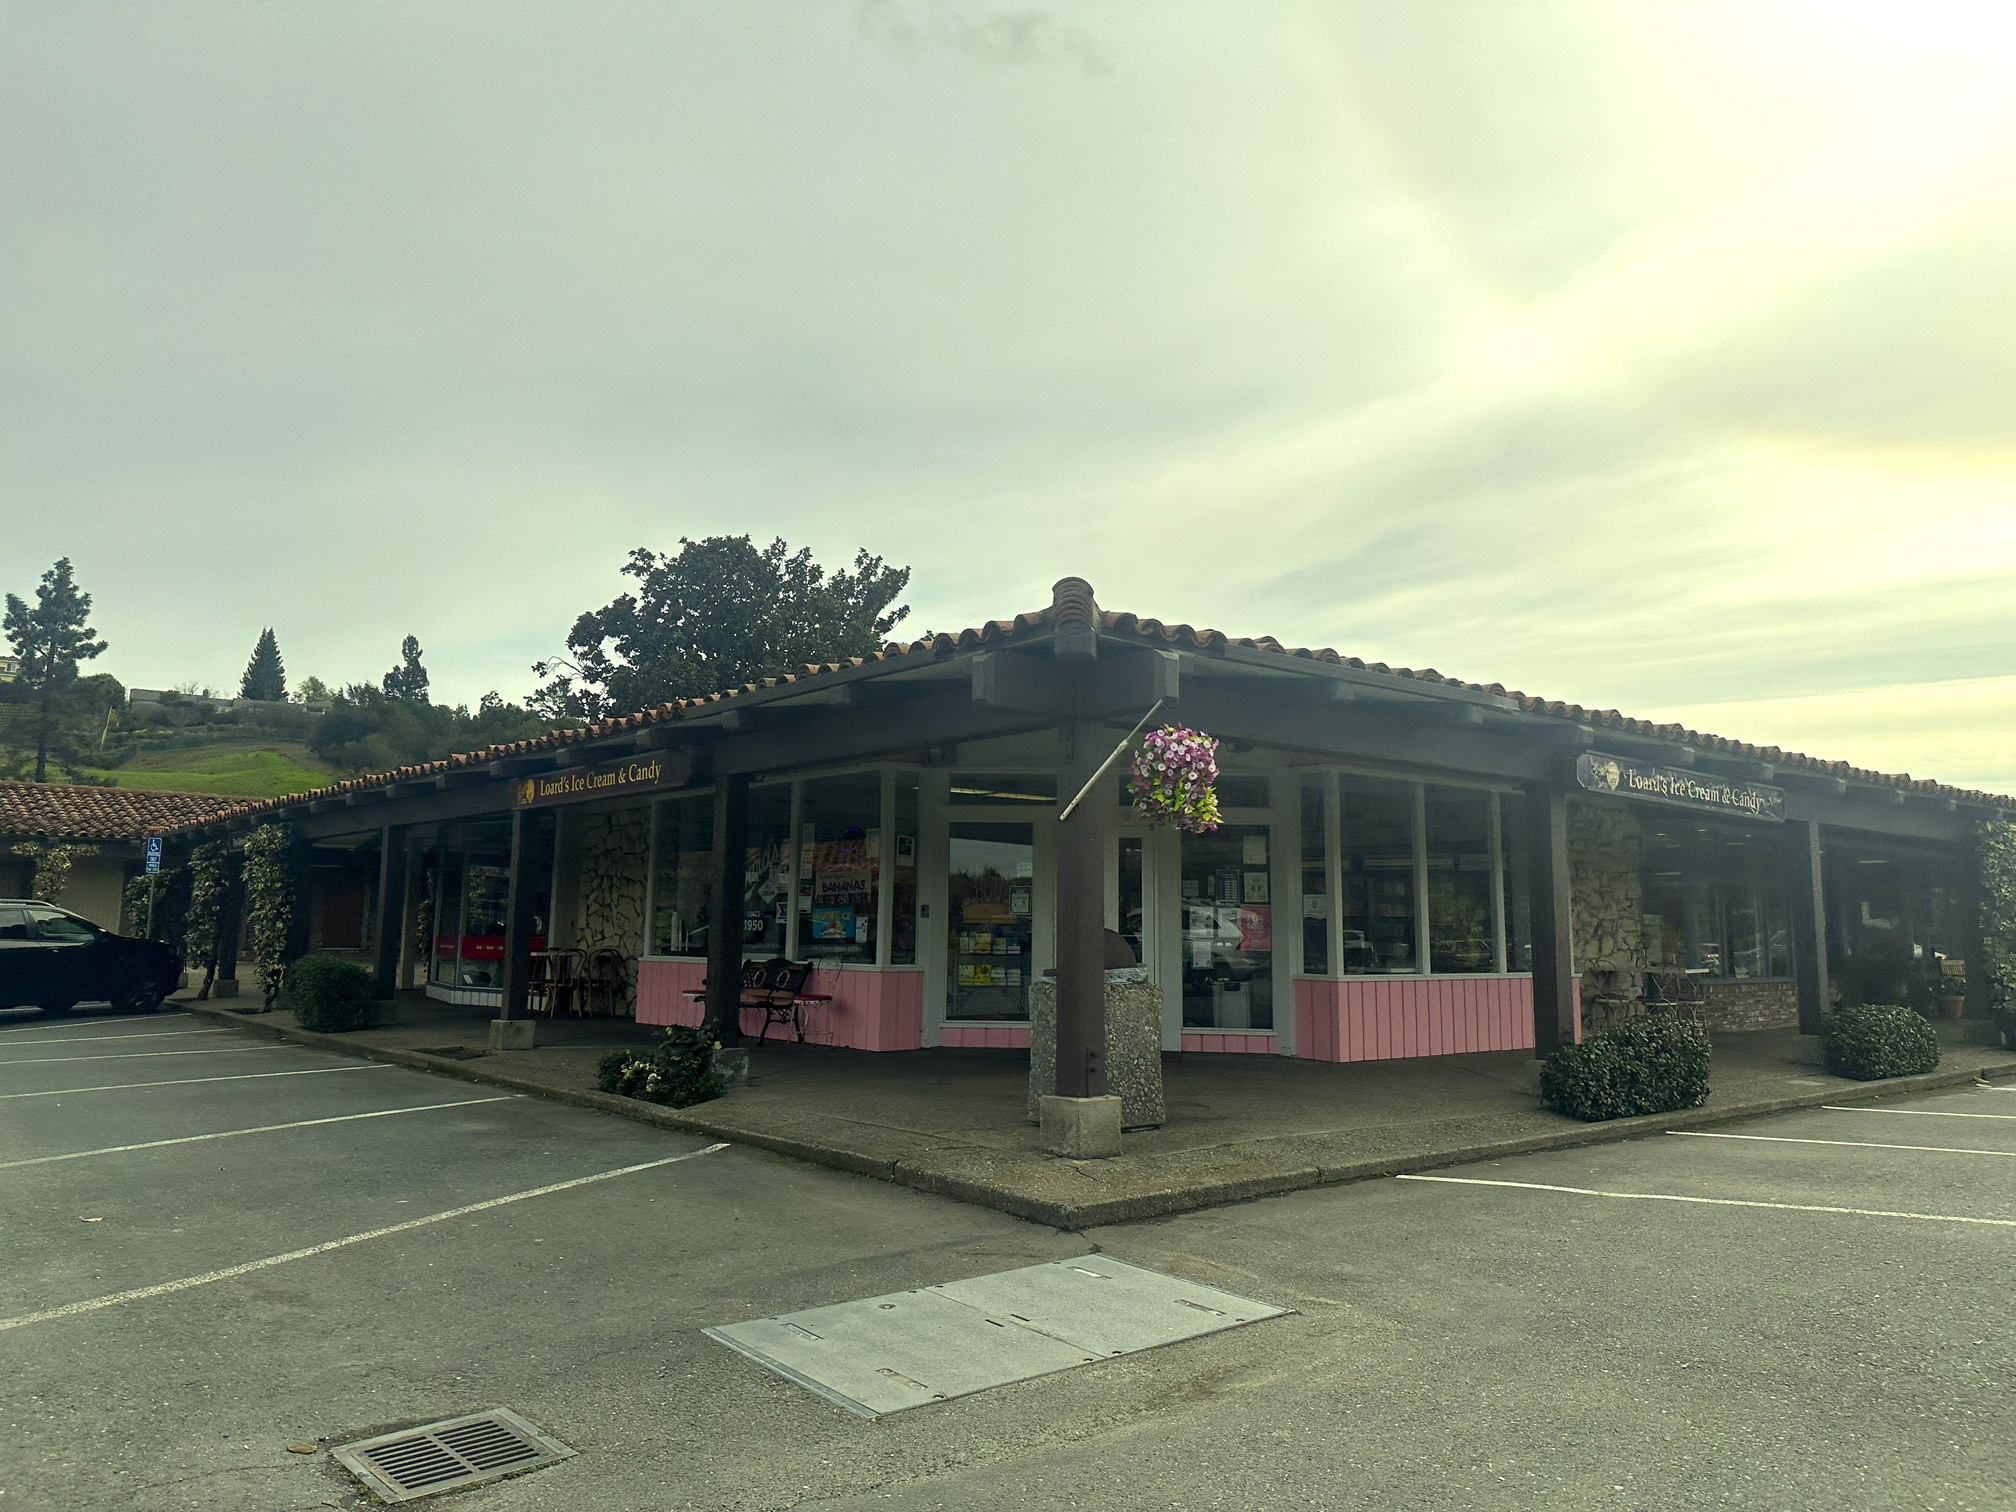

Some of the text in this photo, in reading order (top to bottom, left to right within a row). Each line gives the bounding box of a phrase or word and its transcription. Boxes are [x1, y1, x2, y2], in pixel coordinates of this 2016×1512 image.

[540, 760, 662, 796] Loard's Ice Cream & Candy
[1628, 769, 1763, 815] Loard's Ice Cream & Candy
[822, 880, 866, 893] BANANAS
[743, 919, 764, 932] 1950
